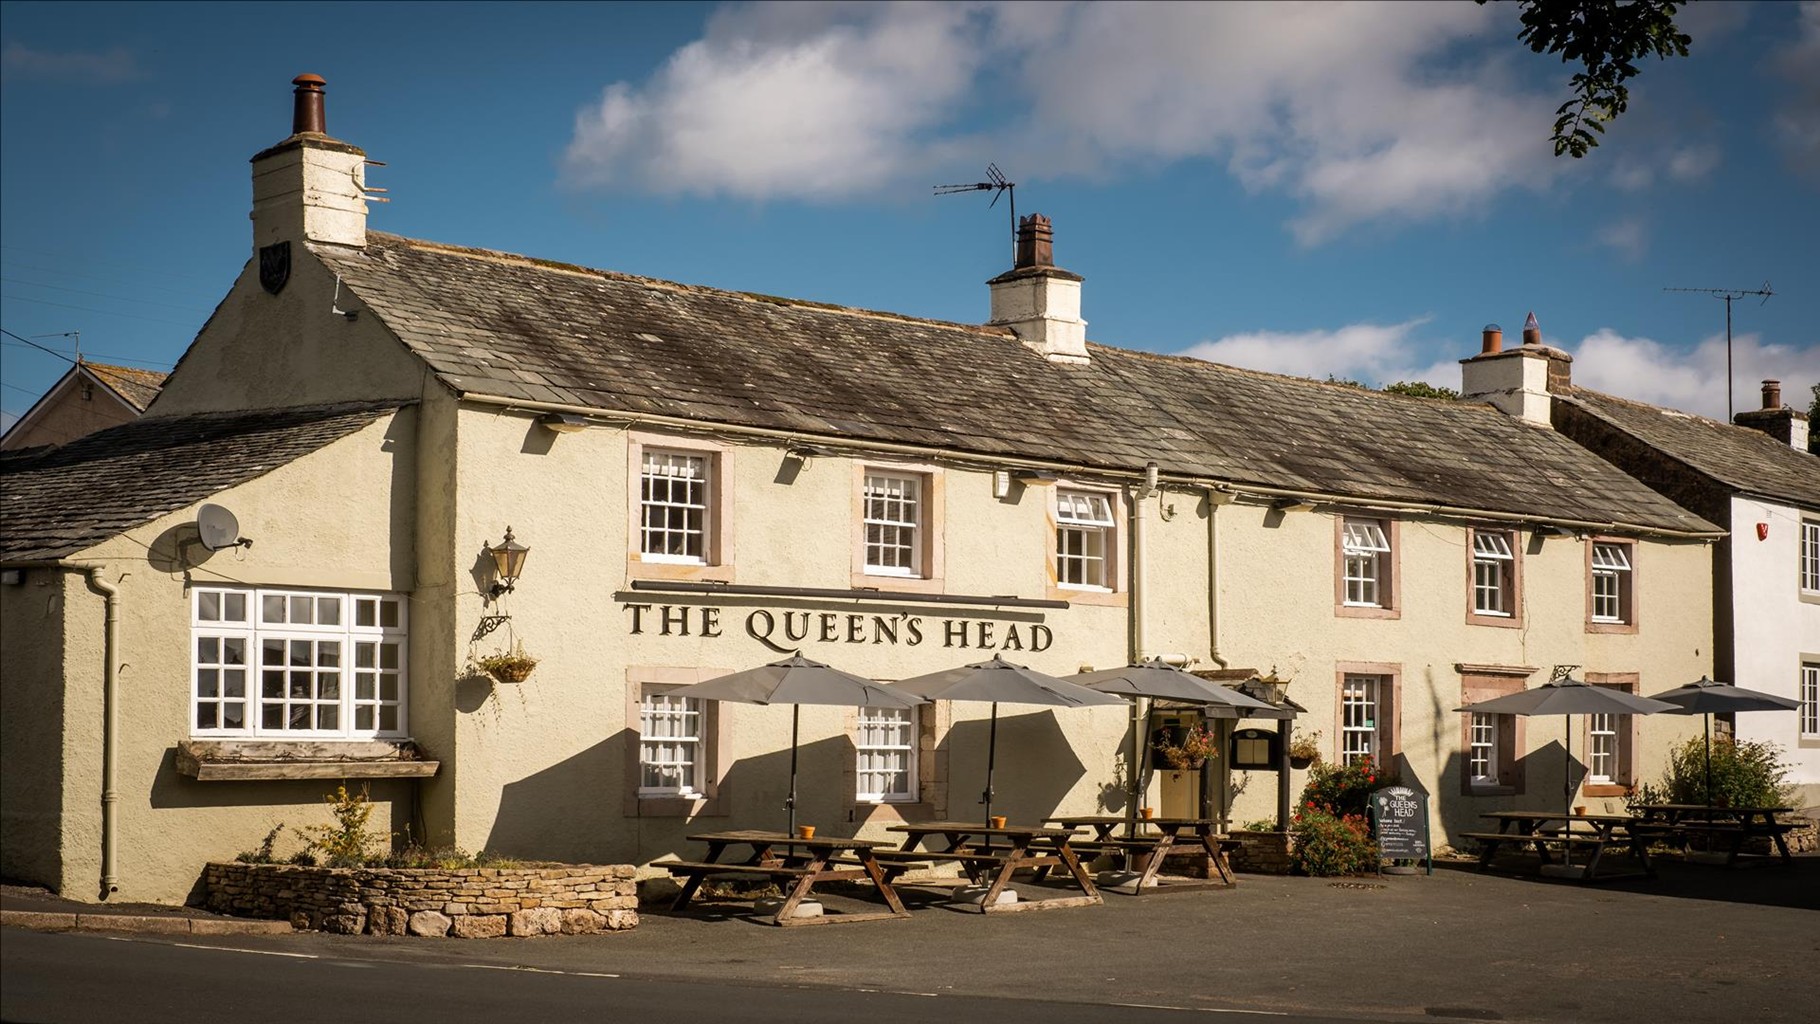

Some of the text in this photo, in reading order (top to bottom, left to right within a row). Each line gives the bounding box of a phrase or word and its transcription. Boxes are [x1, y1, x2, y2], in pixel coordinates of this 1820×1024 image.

[622, 603, 1053, 654] THE QUEEN'S HEAD
[1394, 808, 1414, 817] HEAD
